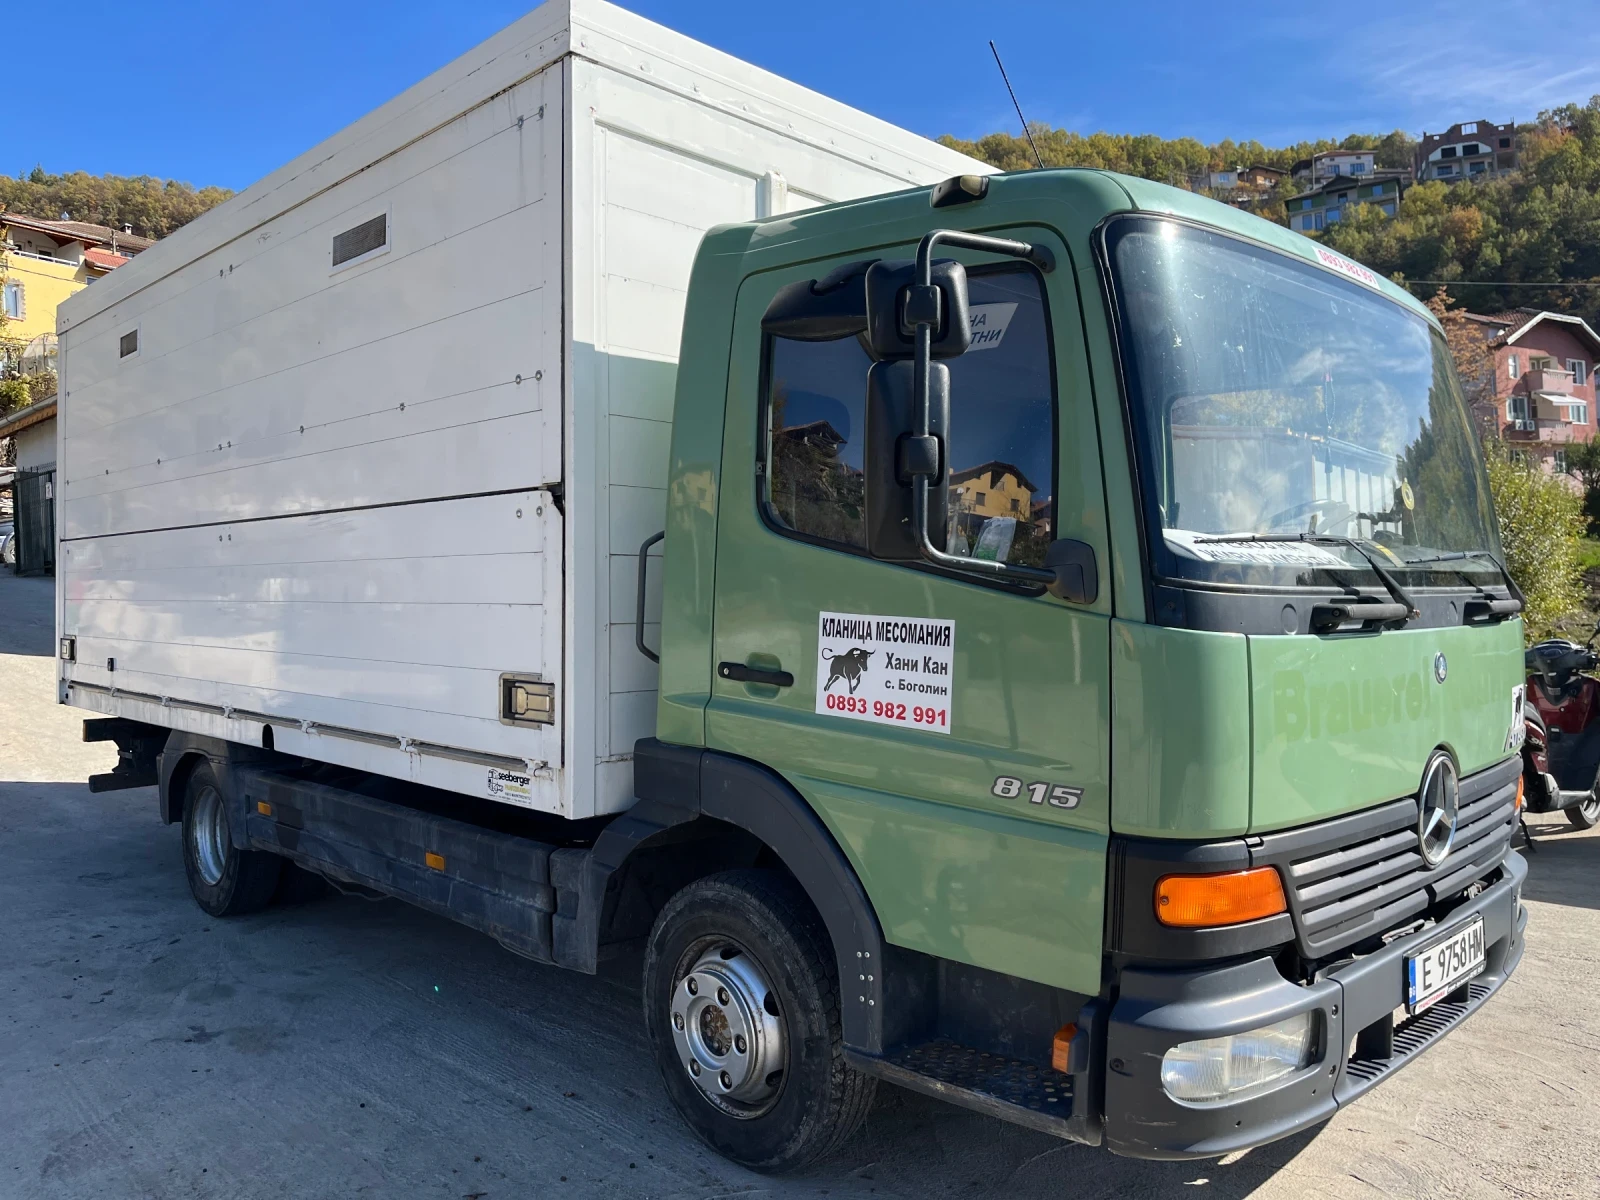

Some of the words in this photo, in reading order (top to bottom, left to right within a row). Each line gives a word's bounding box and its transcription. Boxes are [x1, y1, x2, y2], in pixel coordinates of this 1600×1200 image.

[822, 617, 873, 644] КЛАНИЦА
[876, 621, 951, 647] МЕСОМАНИЯ
[885, 652, 918, 673] Хани
[923, 656, 948, 675] Кан
[885, 679, 895, 690] с.
[898, 679, 947, 696] Боголин
[826, 694, 867, 714] 0893
[873, 701, 906, 721] 982
[913, 706, 946, 726] 991
[498, 770, 530, 787] seeberger
[991, 775, 1085, 810] 815
[1423, 955, 1432, 992] E
[1438, 935, 1466, 982] 9758
